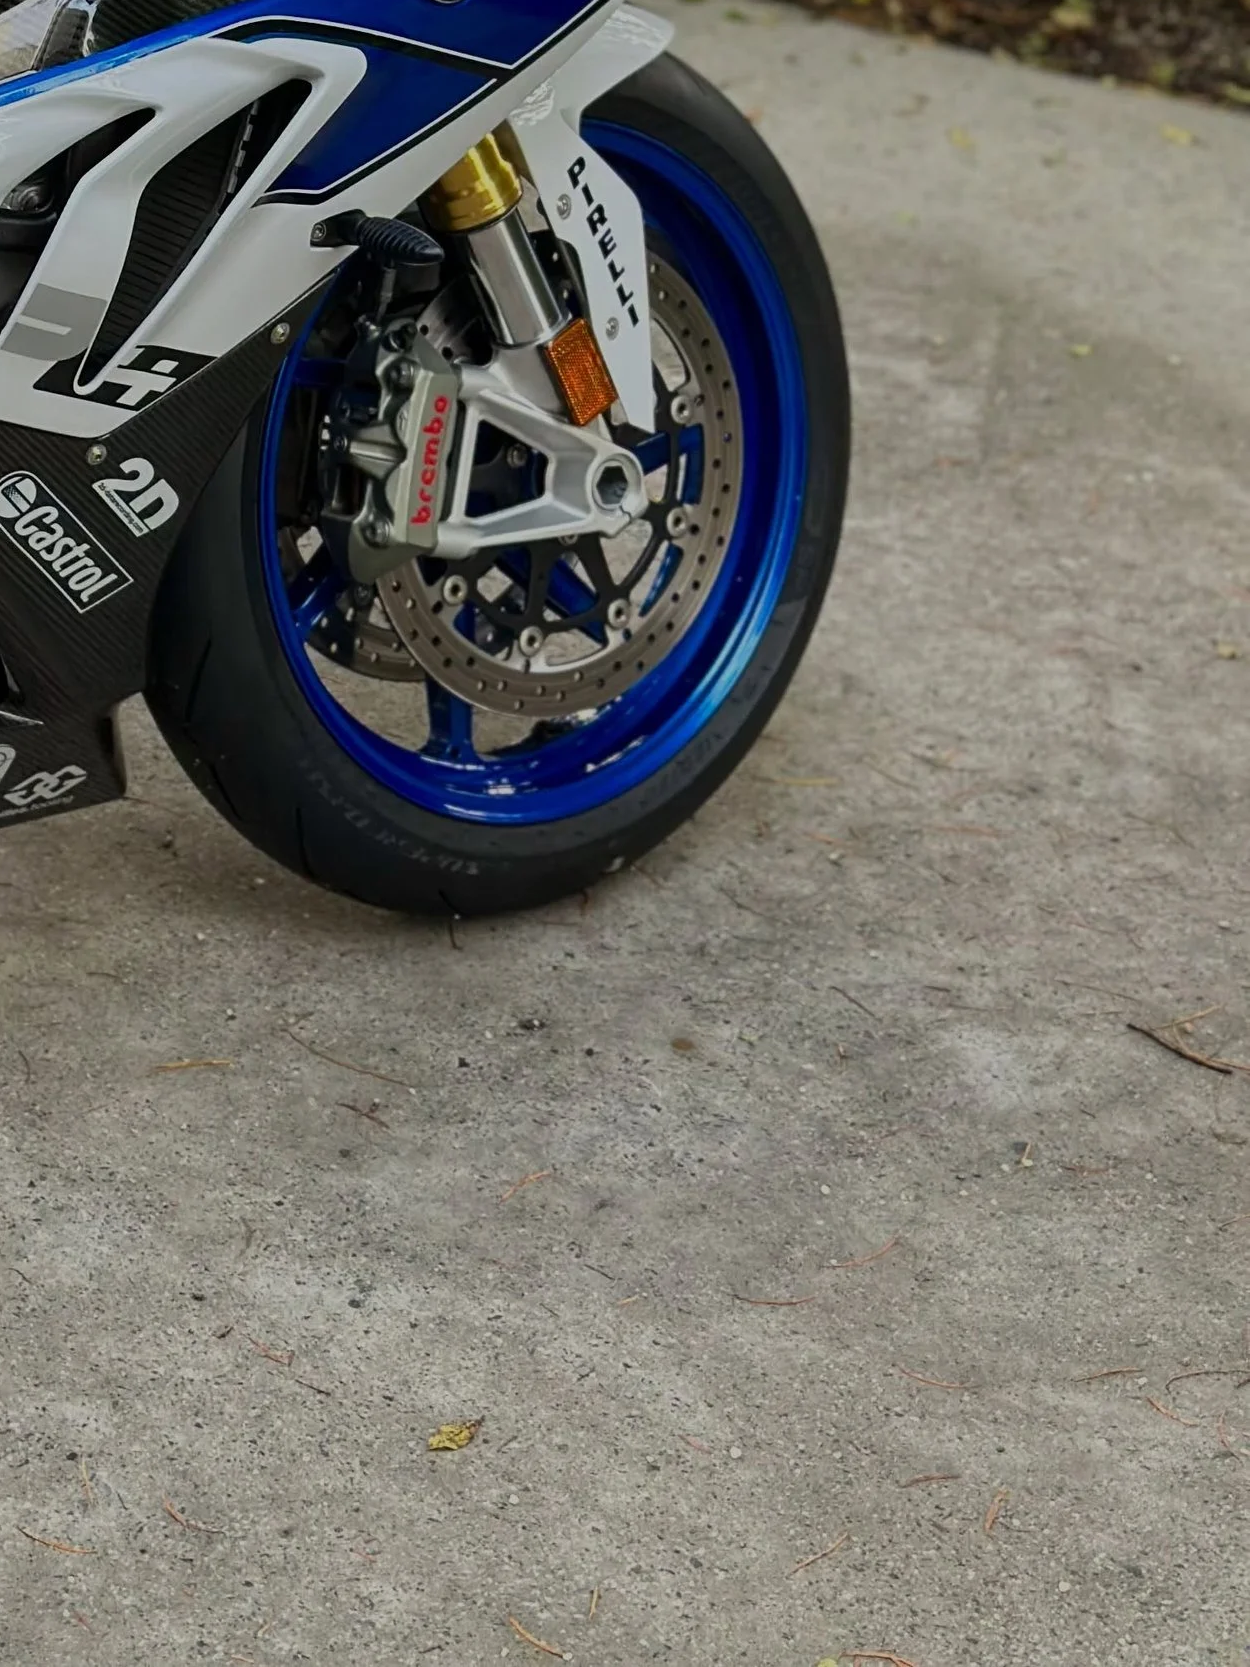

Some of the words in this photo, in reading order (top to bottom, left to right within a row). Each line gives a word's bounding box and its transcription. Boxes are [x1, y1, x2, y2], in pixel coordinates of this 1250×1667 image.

[567, 156, 639, 327] PIRELLI
[92, 457, 180, 537] 2D
[411, 396, 448, 524] brembo
[14, 506, 119, 603] Castrol
